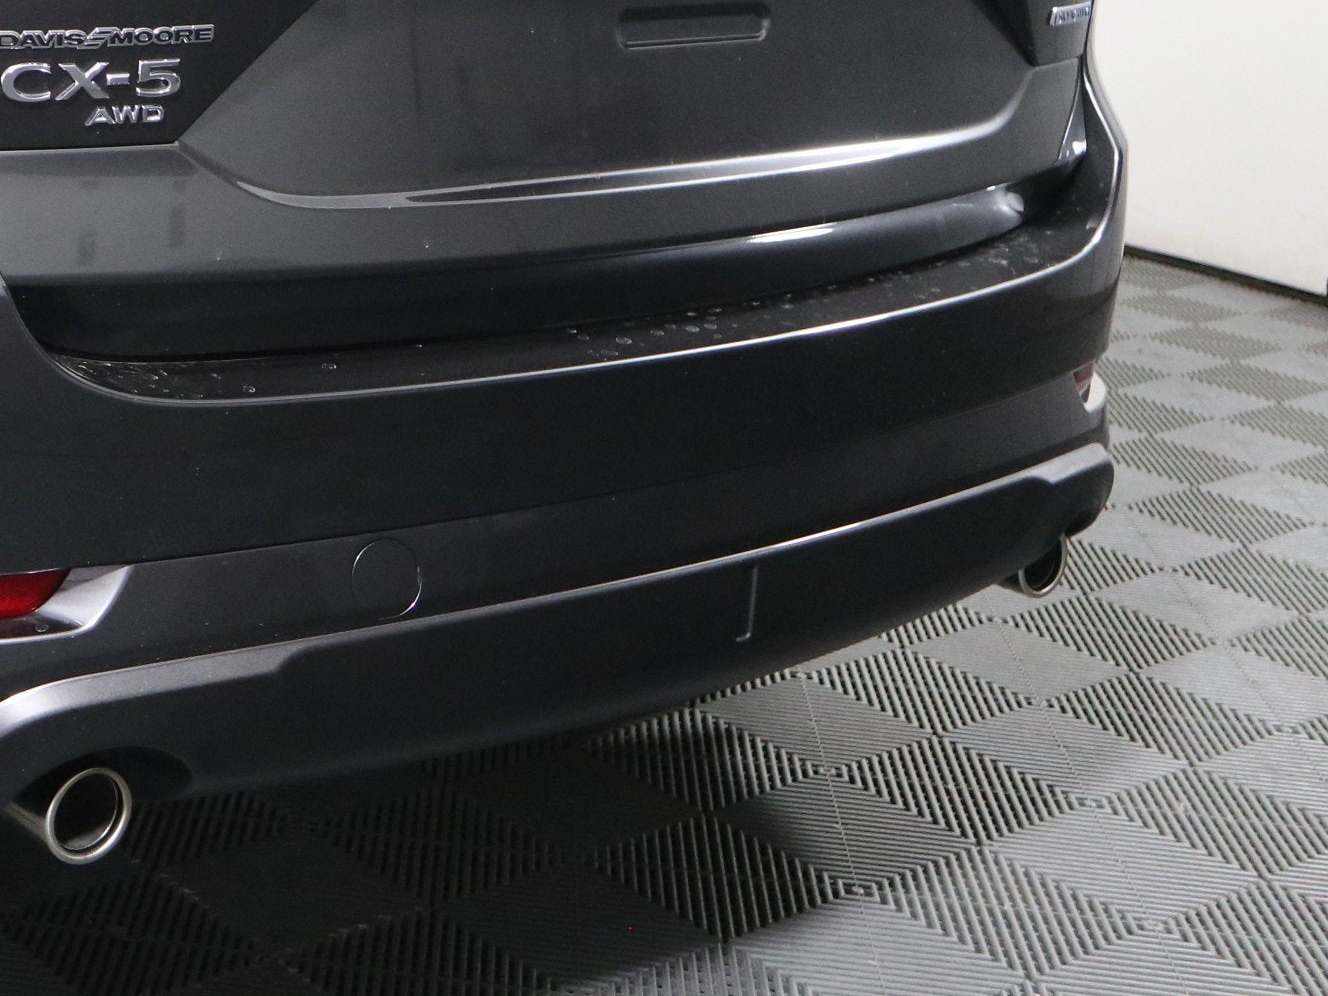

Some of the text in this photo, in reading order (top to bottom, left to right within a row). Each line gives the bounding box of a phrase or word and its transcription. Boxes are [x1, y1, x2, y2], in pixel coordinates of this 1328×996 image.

[107, 24, 215, 47] MOORE
[0, 57, 182, 103] CX-5
[84, 104, 165, 127] AWD
